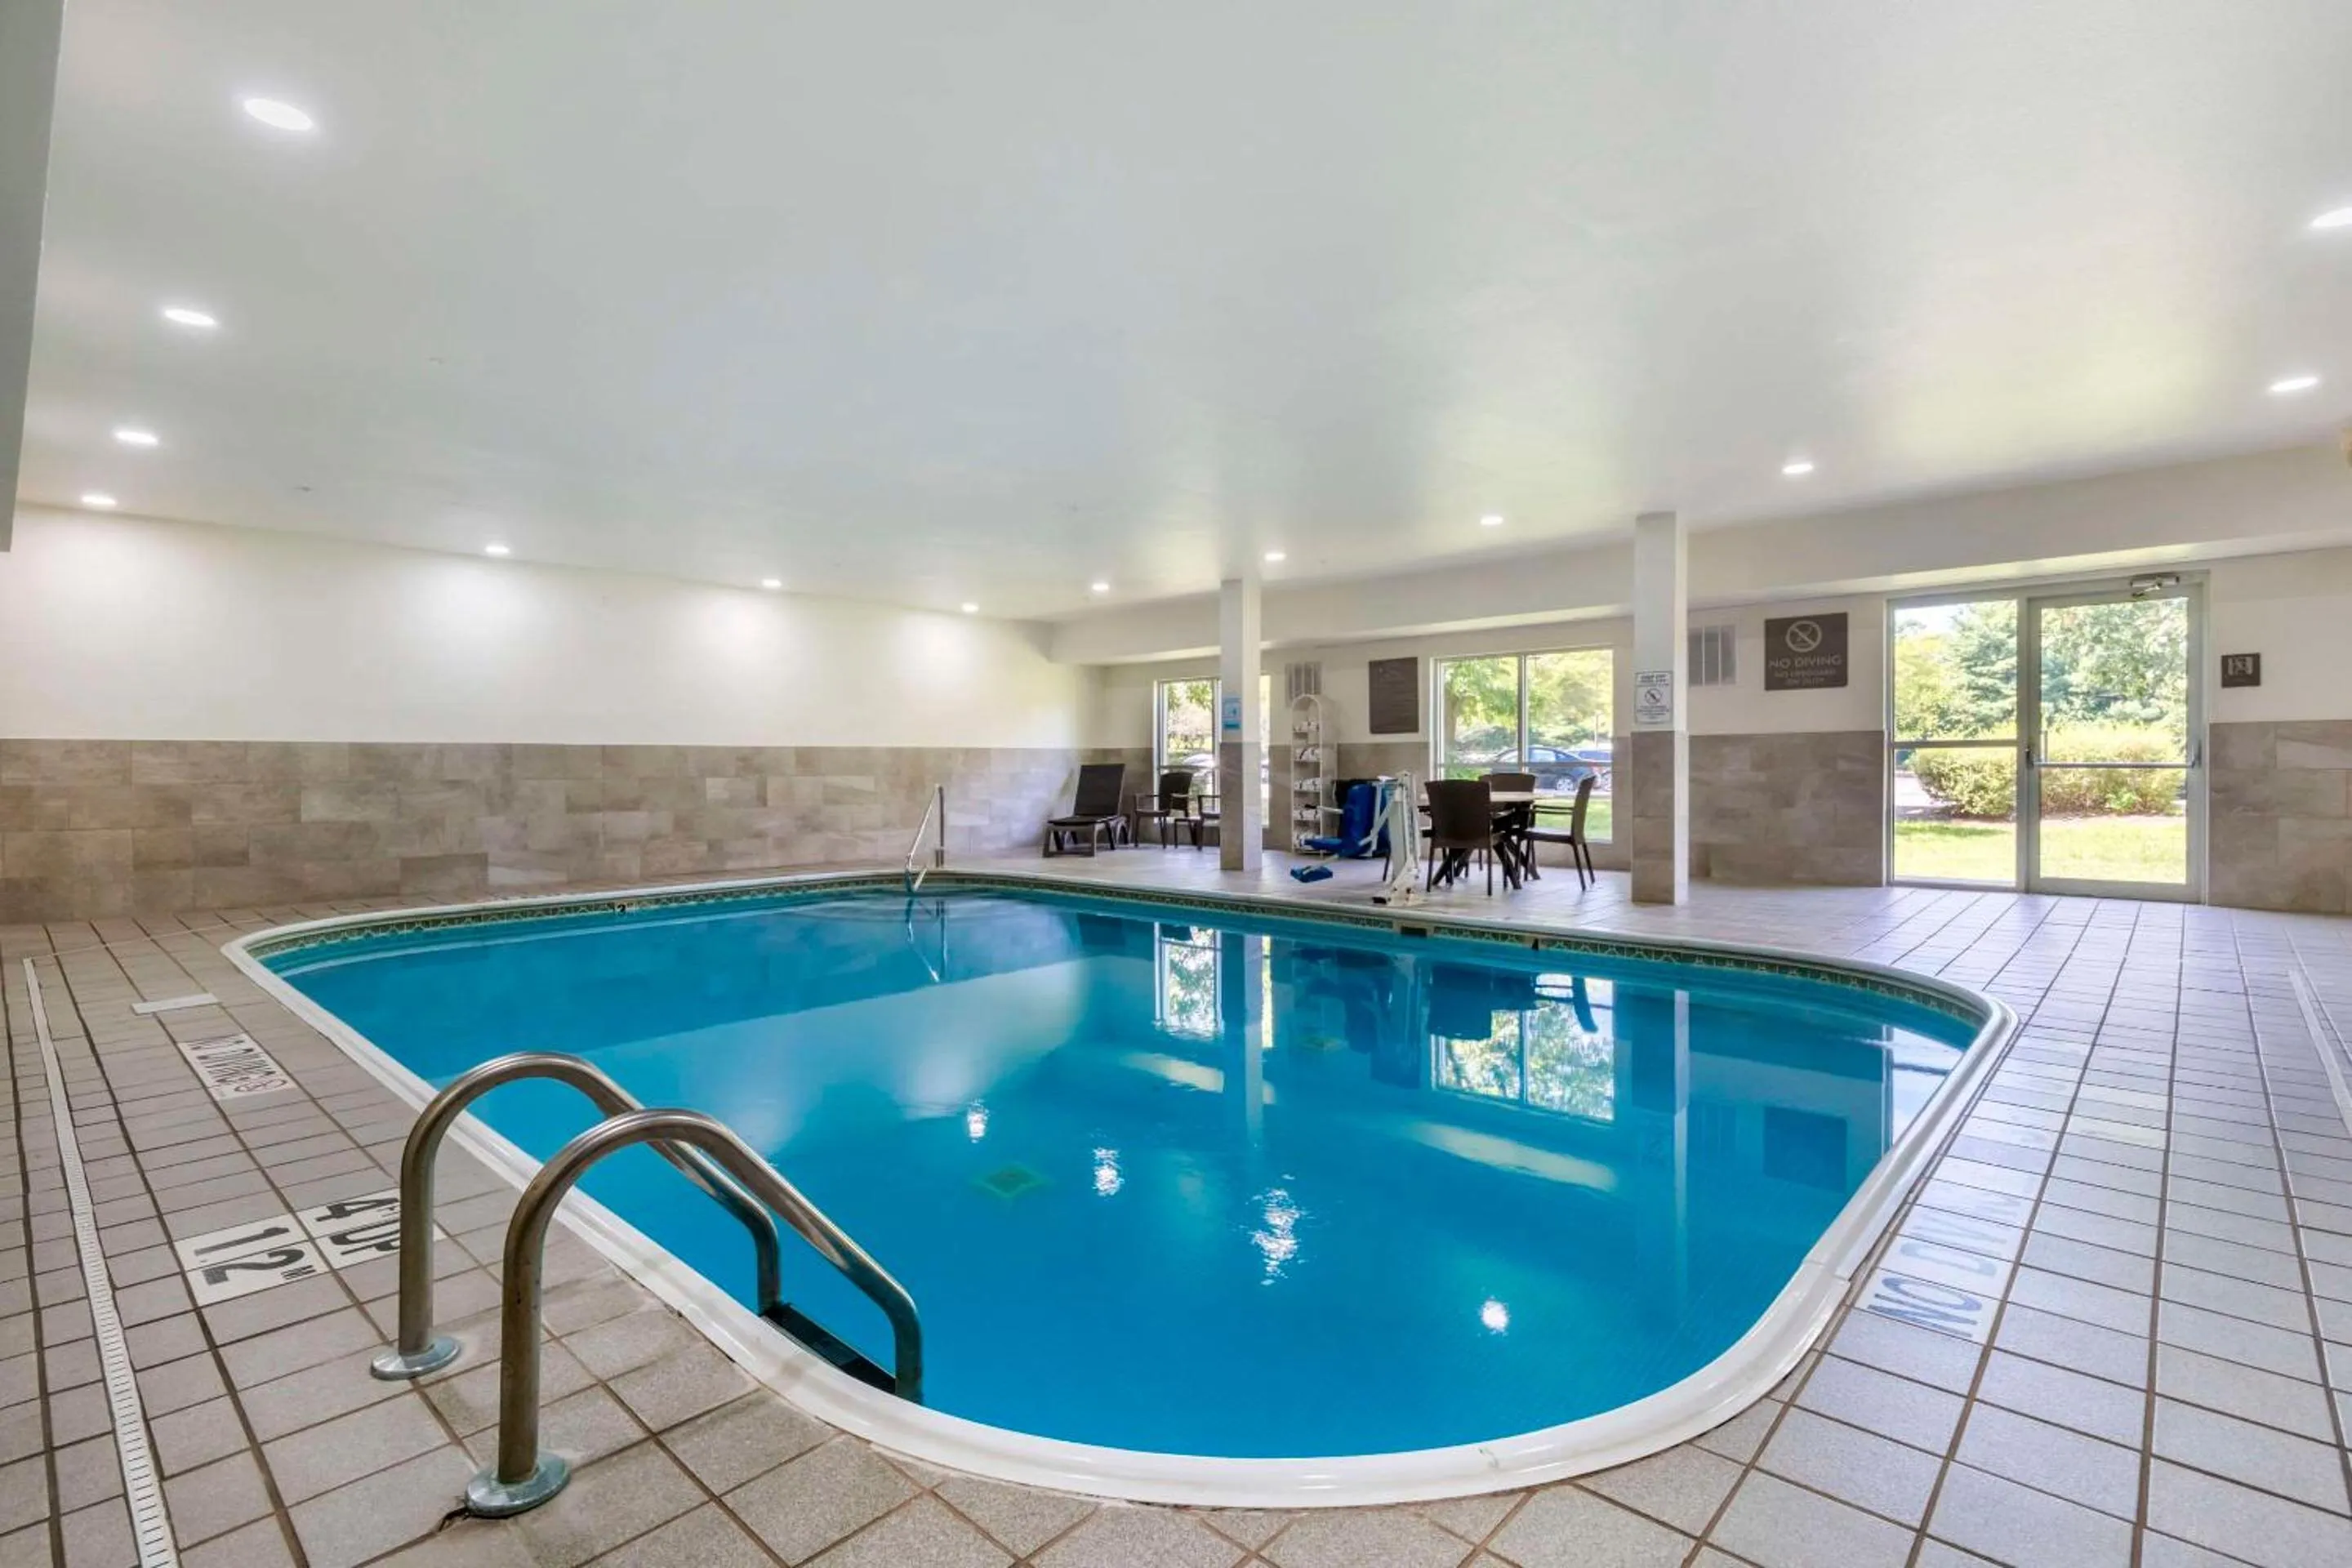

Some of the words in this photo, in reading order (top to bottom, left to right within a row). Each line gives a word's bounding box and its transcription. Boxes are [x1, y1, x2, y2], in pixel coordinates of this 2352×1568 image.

[1768, 657, 1791, 669] NO
[1794, 654, 1842, 667] DIVING
[1867, 1276, 1983, 1339] NO
